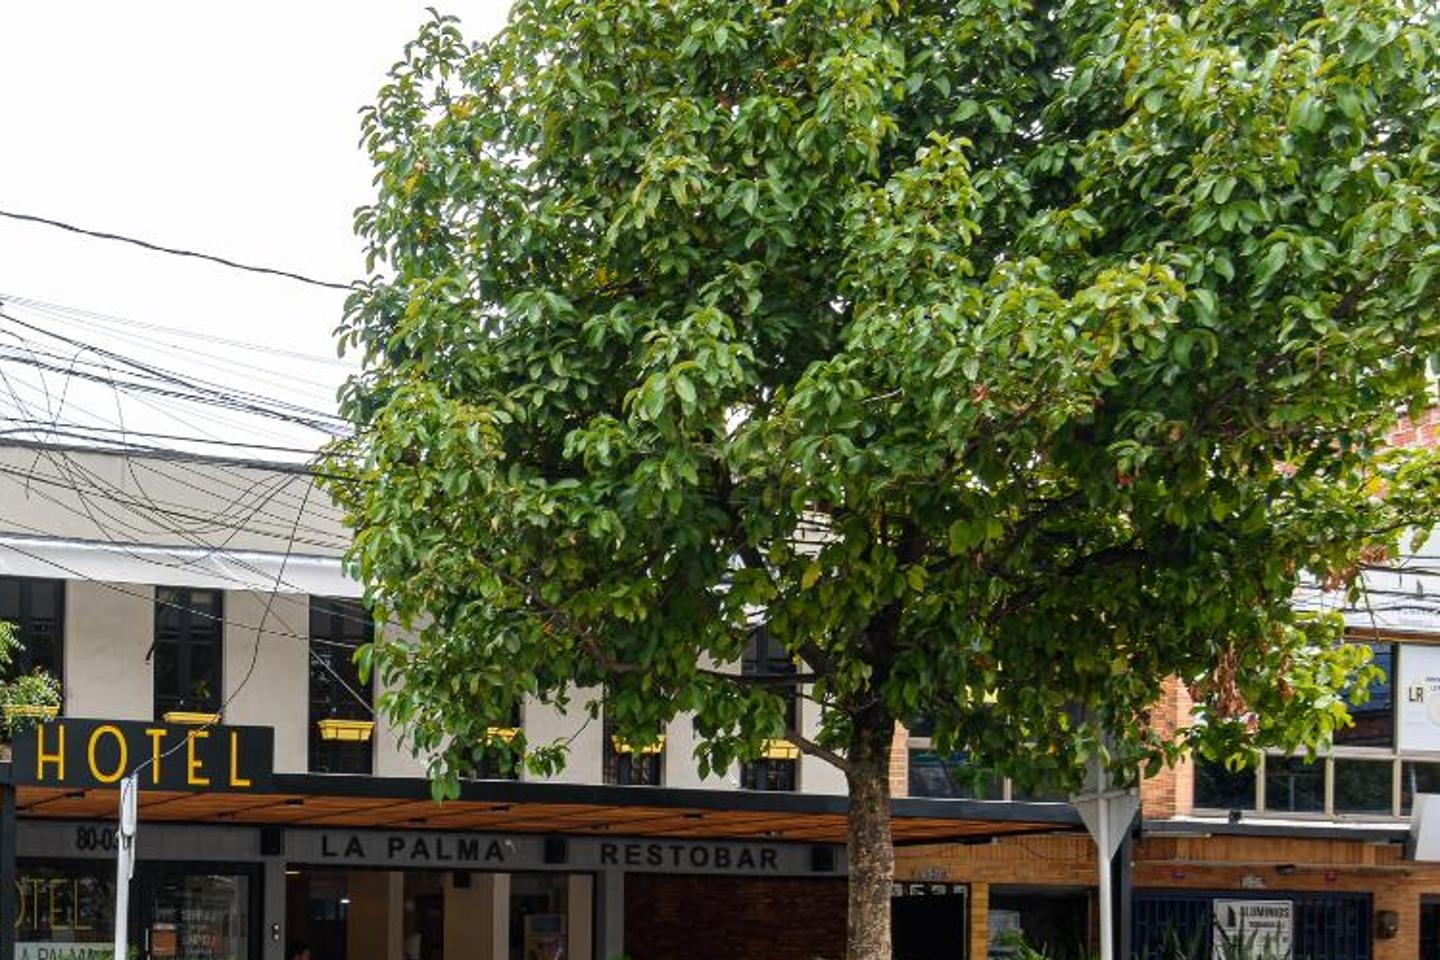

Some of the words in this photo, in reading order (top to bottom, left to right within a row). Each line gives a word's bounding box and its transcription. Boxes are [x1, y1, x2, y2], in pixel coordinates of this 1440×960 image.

[36, 723, 252, 787] HOTEL
[320, 834, 365, 858] LA
[386, 836, 505, 861] PALMA
[600, 843, 779, 870] RESTOBAR
